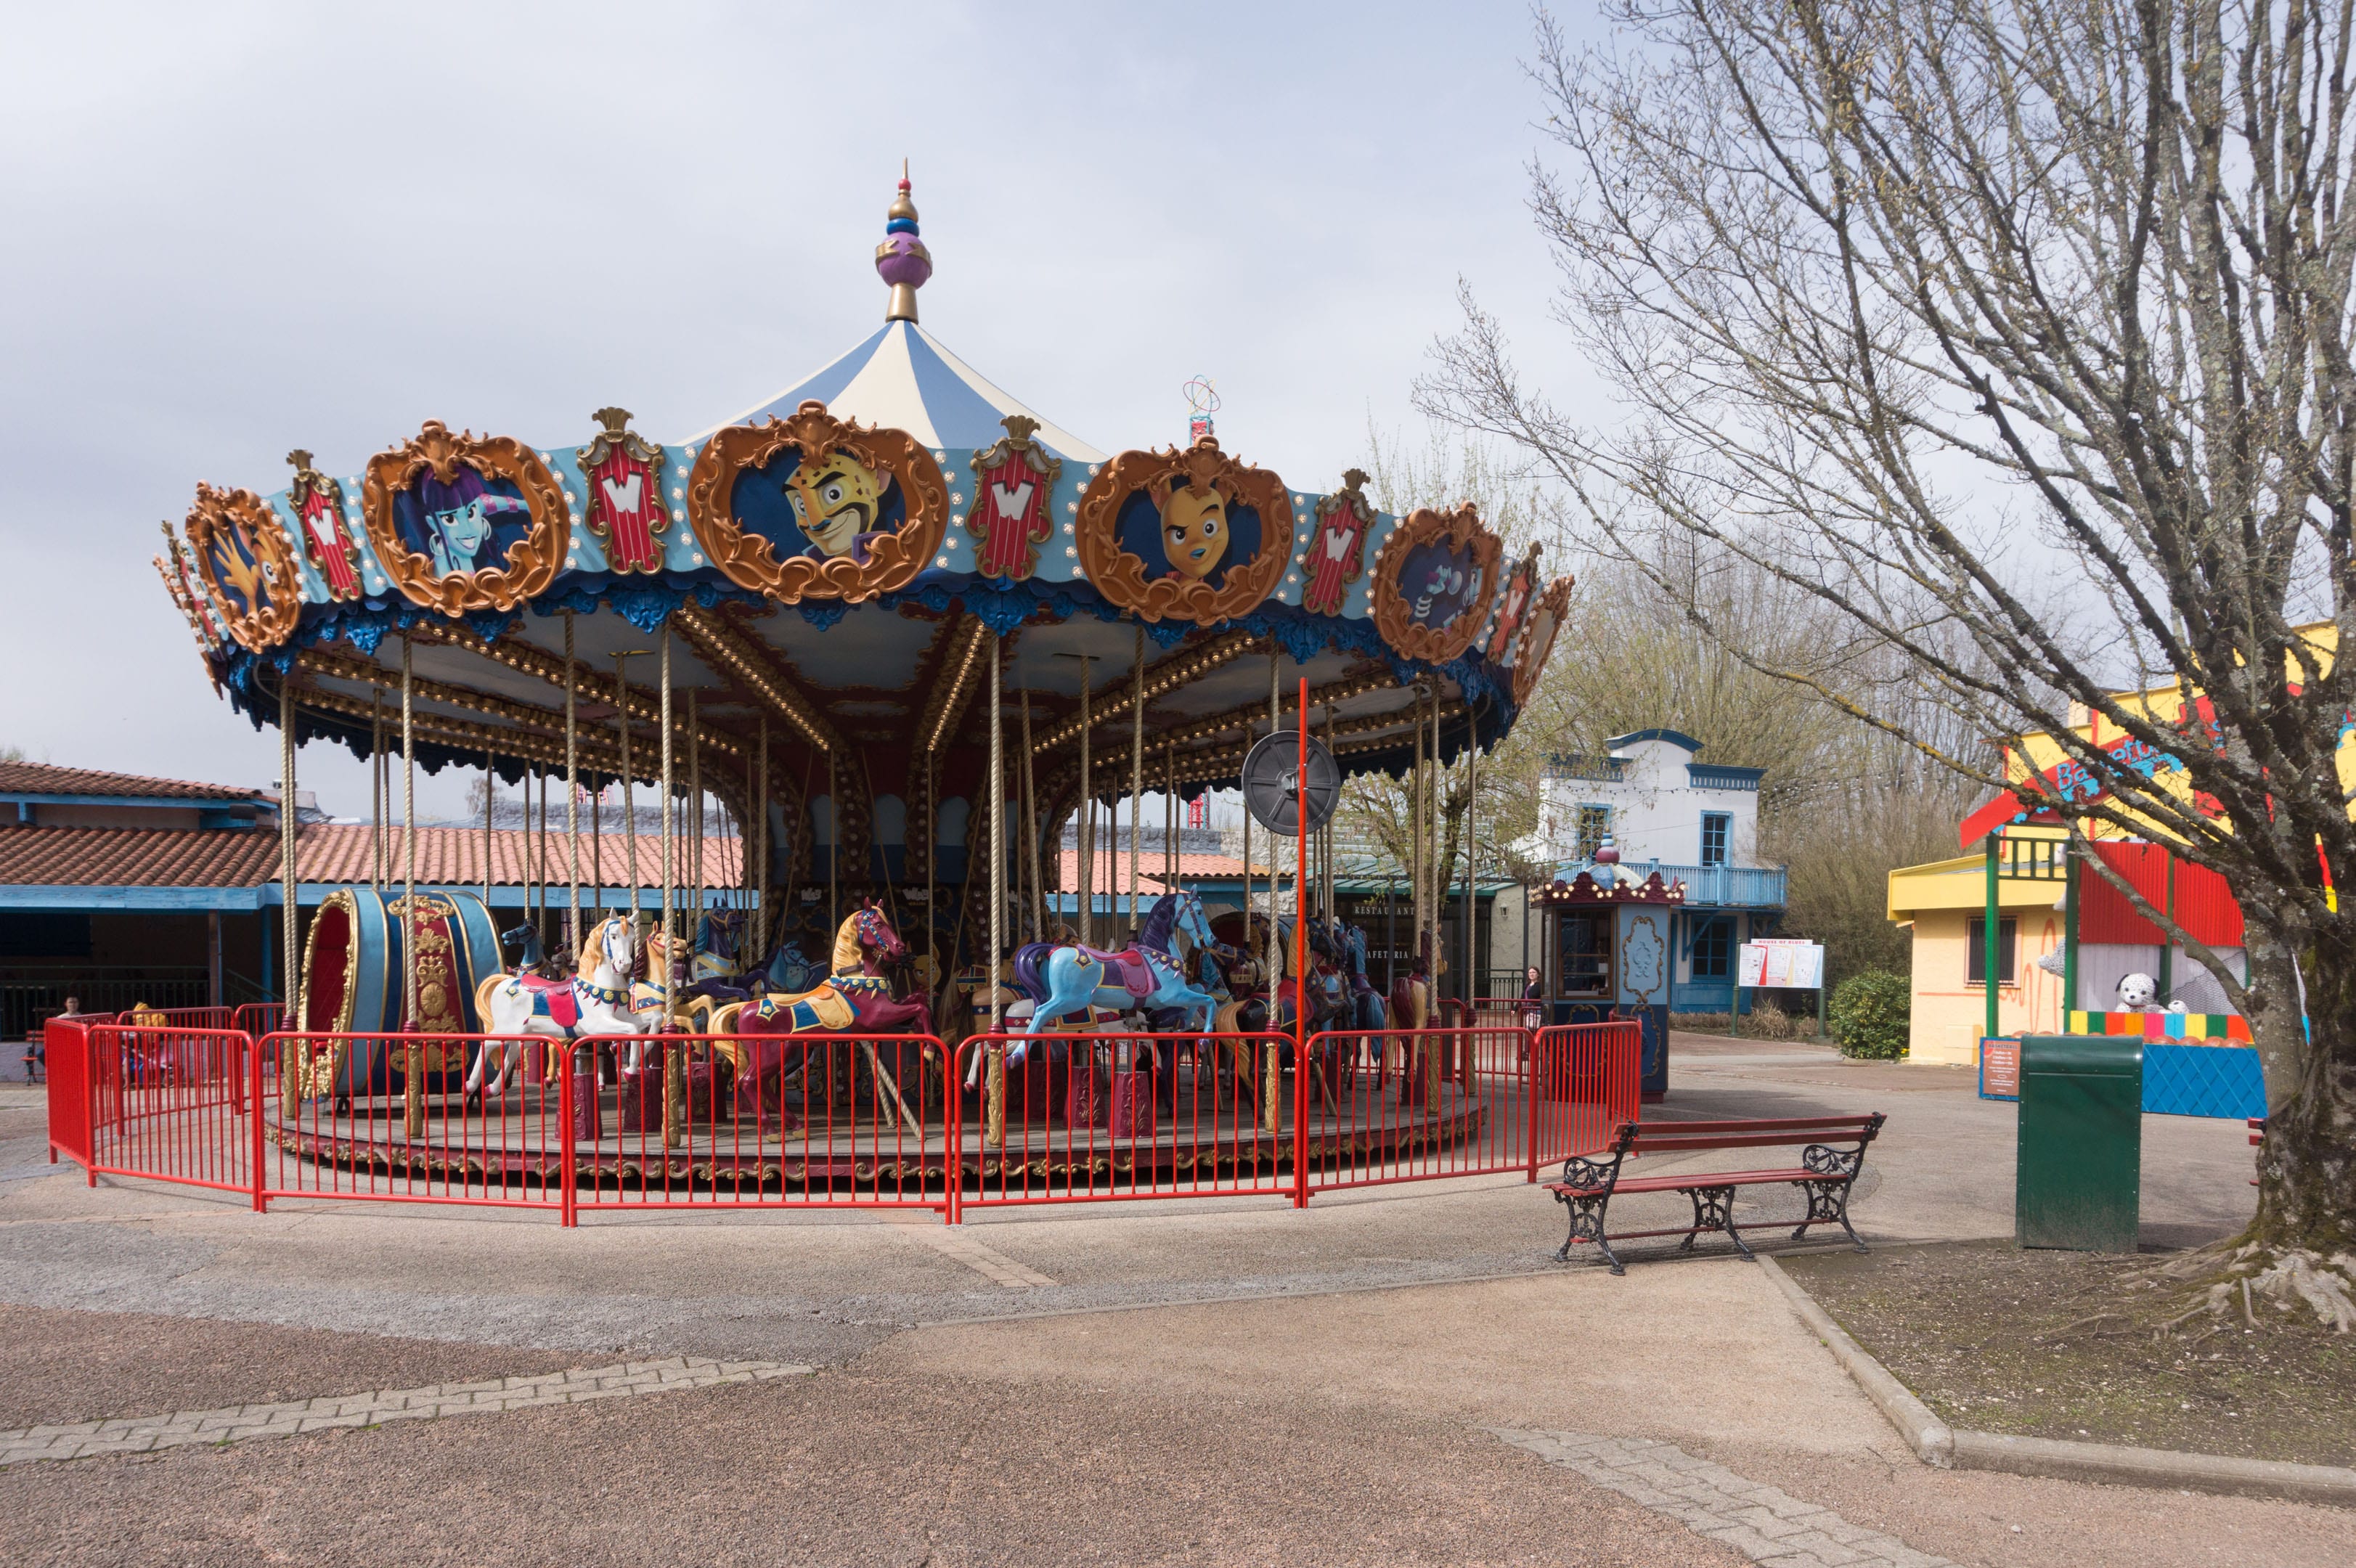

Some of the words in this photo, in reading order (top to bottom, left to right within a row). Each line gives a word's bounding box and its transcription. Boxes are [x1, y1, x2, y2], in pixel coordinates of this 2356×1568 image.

[602, 470, 644, 514] W
[991, 481, 1035, 520] W
[309, 507, 338, 546] W
[1326, 526, 1355, 563] W
[1506, 589, 1524, 619] W
[1355, 906, 1415, 915] RESTAUANT
[1366, 950, 1409, 959] AFETRIA
